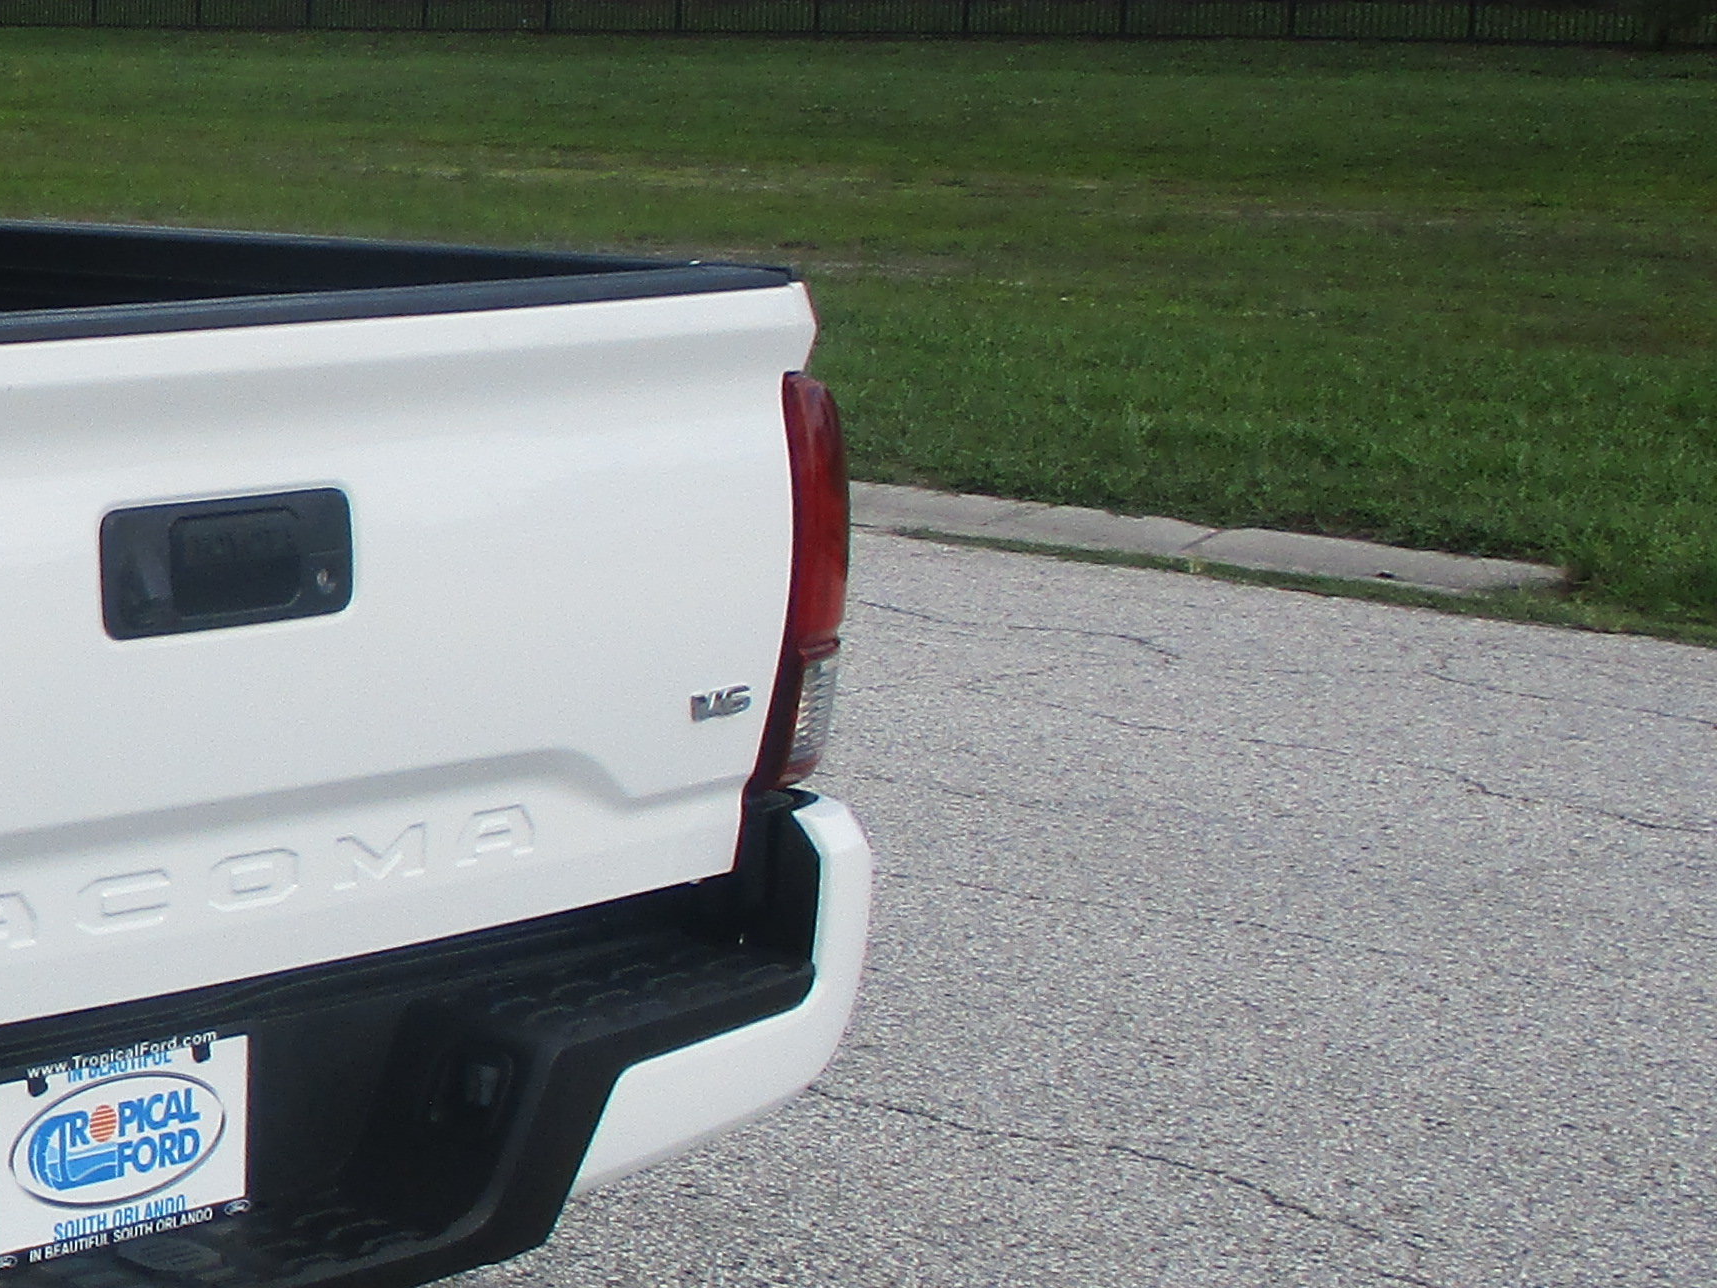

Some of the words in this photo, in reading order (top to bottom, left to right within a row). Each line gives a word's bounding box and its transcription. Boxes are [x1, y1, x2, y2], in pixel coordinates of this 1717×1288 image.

[26, 1030, 217, 1079] www.TropicalFord.com
[117, 1128, 201, 1178] FORD
[29, 1247, 42, 1263] IN
[44, 1233, 110, 1260] BEAUTIFUL
[113, 1222, 153, 1244] SOUTH
[156, 1207, 214, 1232] ORLANDO
[54, 1213, 107, 1242] SOUTH
